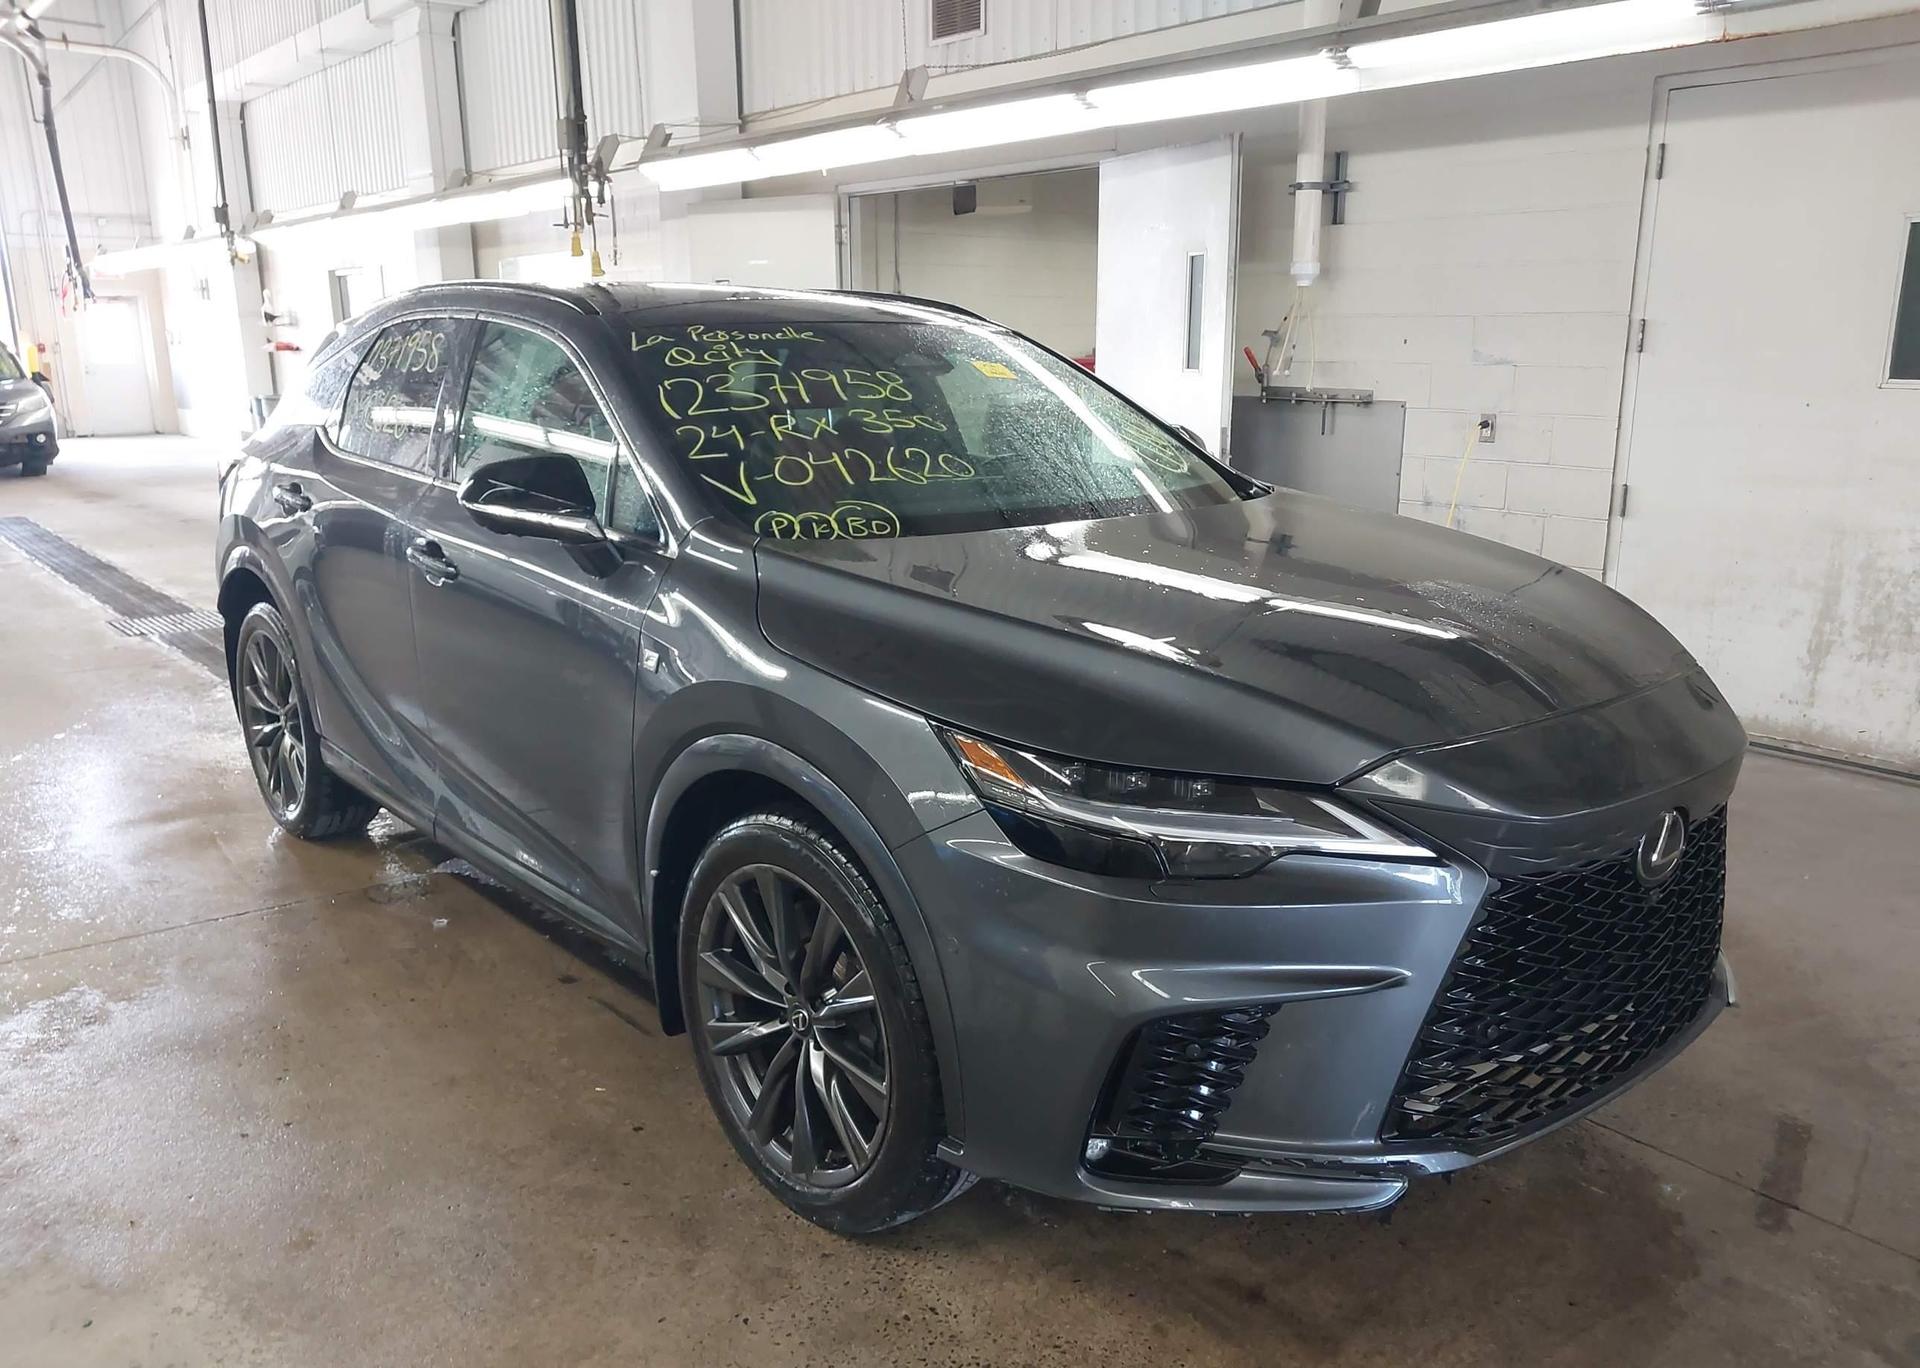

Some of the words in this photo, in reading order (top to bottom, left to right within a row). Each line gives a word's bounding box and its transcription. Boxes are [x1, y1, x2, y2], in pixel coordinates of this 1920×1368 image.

[632, 331, 675, 351] La
[658, 369, 912, 420] 12371958
[848, 408, 948, 433] 350
[700, 446, 976, 505] V-042620
